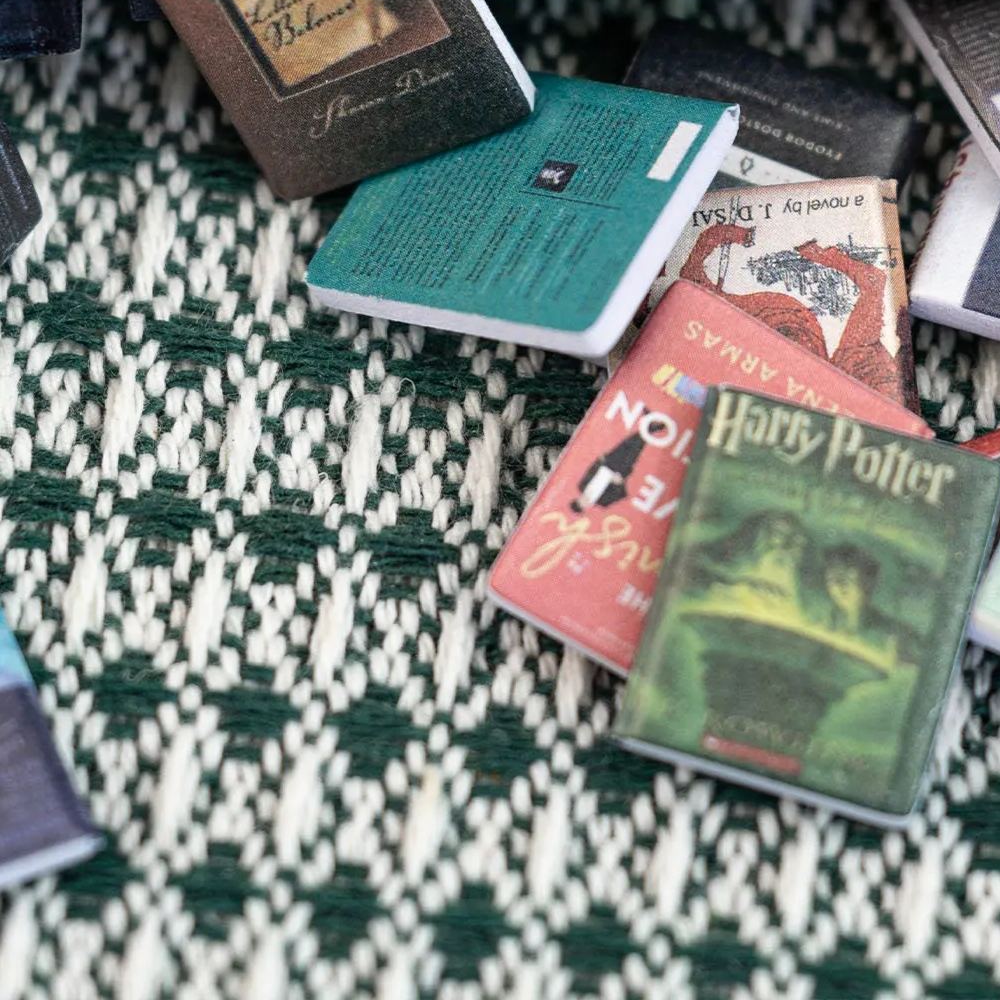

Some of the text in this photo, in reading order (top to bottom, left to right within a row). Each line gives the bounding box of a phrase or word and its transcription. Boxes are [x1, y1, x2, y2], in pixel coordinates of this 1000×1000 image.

[782, 198, 804, 214] by
[806, 194, 850, 216] novel
[853, 194, 865, 208] a
[683, 319, 779, 383] ARMAS
[706, 391, 956, 506] Harry Potter
